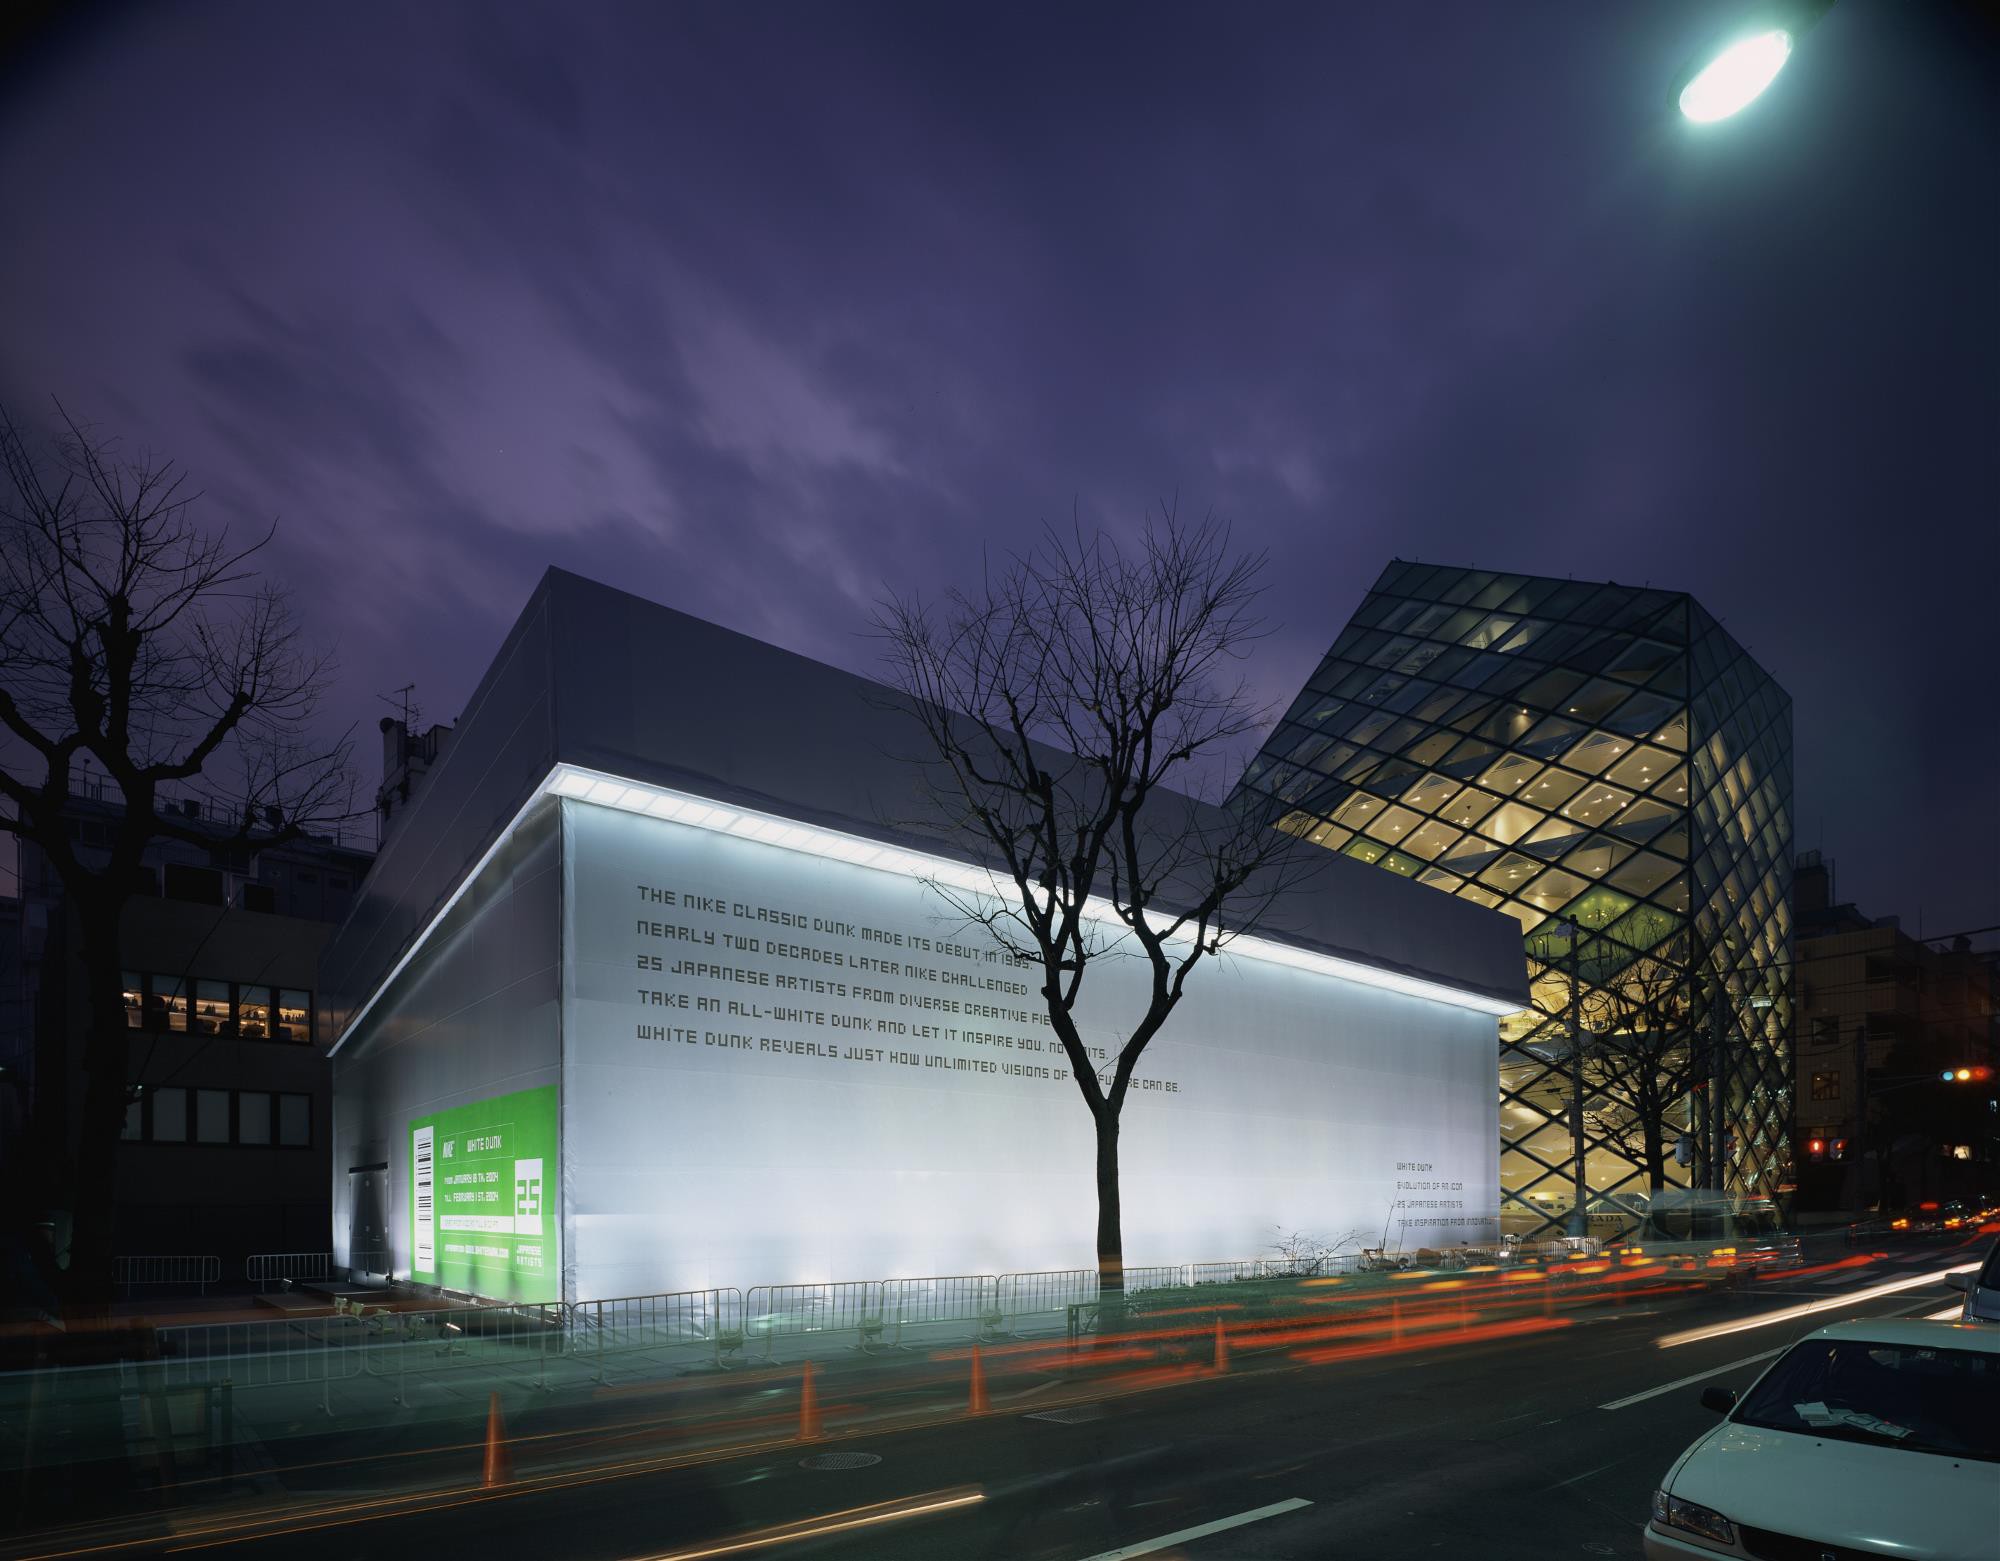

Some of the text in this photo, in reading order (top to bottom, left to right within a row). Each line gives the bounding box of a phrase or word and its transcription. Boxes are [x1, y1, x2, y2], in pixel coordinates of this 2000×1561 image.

[637, 885, 676, 906] THE
[684, 894, 726, 914] NIKE
[733, 903, 807, 929] CLASSIC
[814, 918, 856, 938] DUNK
[862, 927, 902, 947] MADE
[908, 936, 930, 951] ITS
[936, 941, 981, 961] DEBUT
[985, 950, 997, 963] IN
[637, 920, 1028, 996] NEARLY TWO DECADES LATER NIKE CHALLENGED
[637, 955, 663, 972] 25
[671, 960, 769, 987] JAPANESE
[776, 974, 846, 997] ARTISTS
[852, 986, 894, 1005] FROM
[900, 993, 959, 1013] DIVERSE
[964, 1003, 1028, 1024] CREATIVE
[638, 989, 689, 1009] TAKE
[697, 997, 721, 1013] AN
[728, 1001, 825, 1025] ALL-WHITE
[831, 1014, 872, 1031] DUNK
[878, 1020, 906, 1035] AND
[912, 1024, 940, 1039] LET
[944, 1028, 957, 1041] IT
[963, 1030, 1013, 1048] INSPIRE
[1017, 1038, 1045, 1052] YOU.
[1049, 1041, 1064, 1054] NO
[637, 1024, 697, 1044] WHITE
[706, 1032, 753, 1050] DUNK
[760, 1038, 838, 1058] REVEALS
[844, 1047, 884, 1062] JUST
[890, 1051, 920, 1066] HOW
[925, 1055, 997, 1074] UNLIMITED
[1001, 1063, 1049, 1079] VISIONS
[1053, 1069, 1068, 1081] OF
[1142, 1079, 1162, 1091] CAN
[1165, 1081, 1182, 1093] BE.
[467, 1137, 484, 1153] WHITE
[485, 1135, 502, 1150] DUNK
[1397, 1162, 1432, 1172] WHITE DUNK
[1397, 1181, 1431, 1190] EVOLUTION
[1432, 1182, 1440, 1190] OF
[1397, 1200, 1463, 1209] 25 JAPANESE ARTISTS
[1397, 1219, 1413, 1228] TAKE
[1414, 1219, 1449, 1228] INSPIRATION
